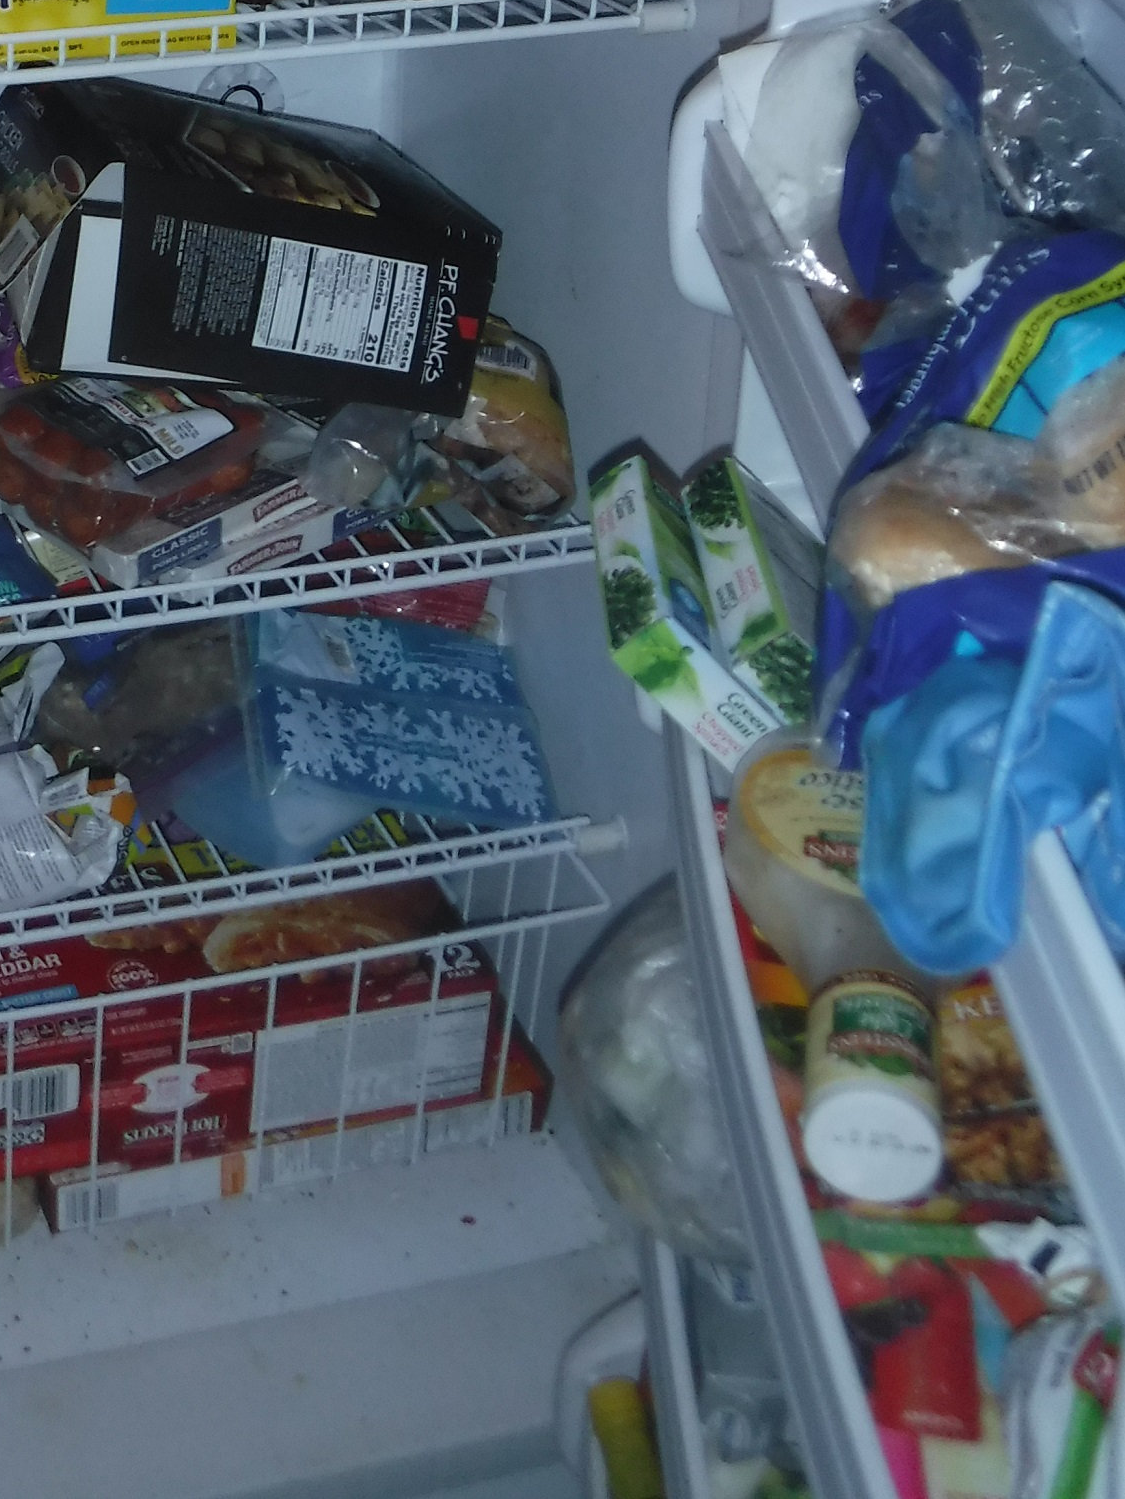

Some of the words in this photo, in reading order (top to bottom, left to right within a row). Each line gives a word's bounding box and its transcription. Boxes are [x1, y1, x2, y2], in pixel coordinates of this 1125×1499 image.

[374, 260, 389, 311] Calories
[410, 266, 425, 328] Nutrition
[364, 334, 378, 363] 210
[399, 333, 414, 369] Facts
[425, 297, 455, 382] CHANG'S
[1007, 308, 1054, 371] Fructose
[151, 526, 209, 558] CLASSIC
[716, 702, 756, 738] Giant
[727, 692, 768, 733] Green
